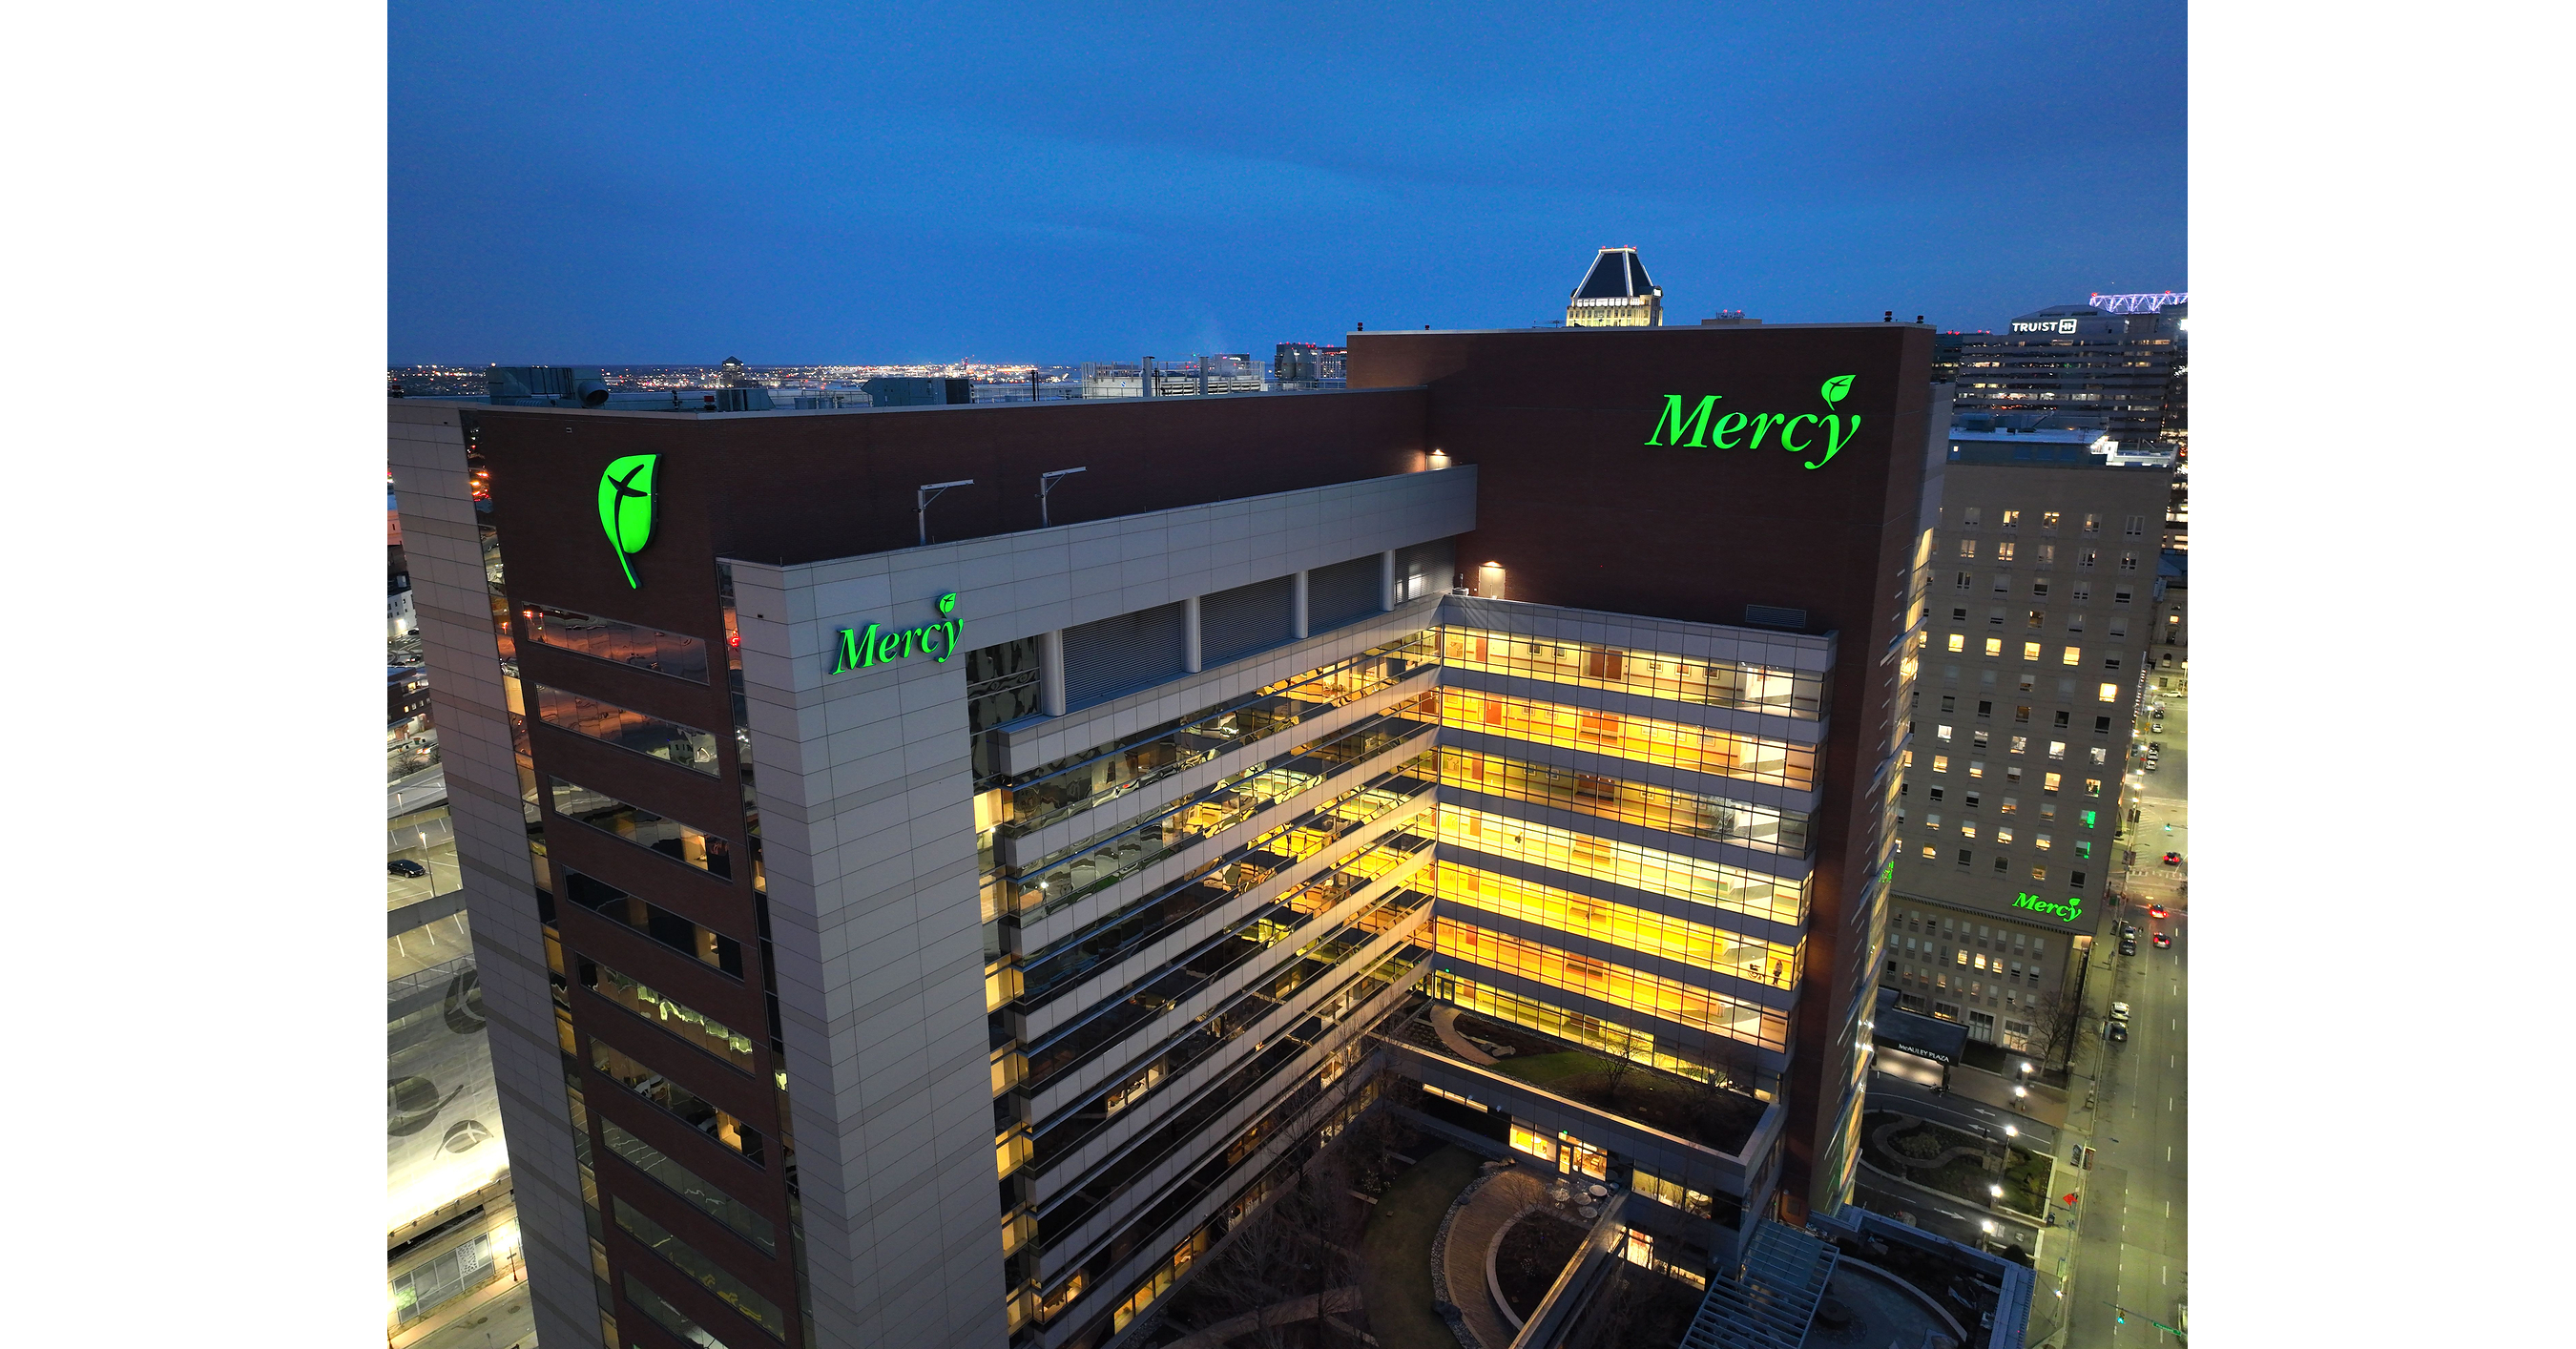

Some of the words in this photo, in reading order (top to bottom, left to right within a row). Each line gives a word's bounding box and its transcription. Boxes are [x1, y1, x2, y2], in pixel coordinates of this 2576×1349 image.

[2011, 322, 2059, 333] TRUIST
[1643, 394, 1861, 470] Mercy
[832, 618, 965, 675] Mercy
[2011, 892, 2083, 923] Mercy
[1928, 1051, 1950, 1063] PLAZA
